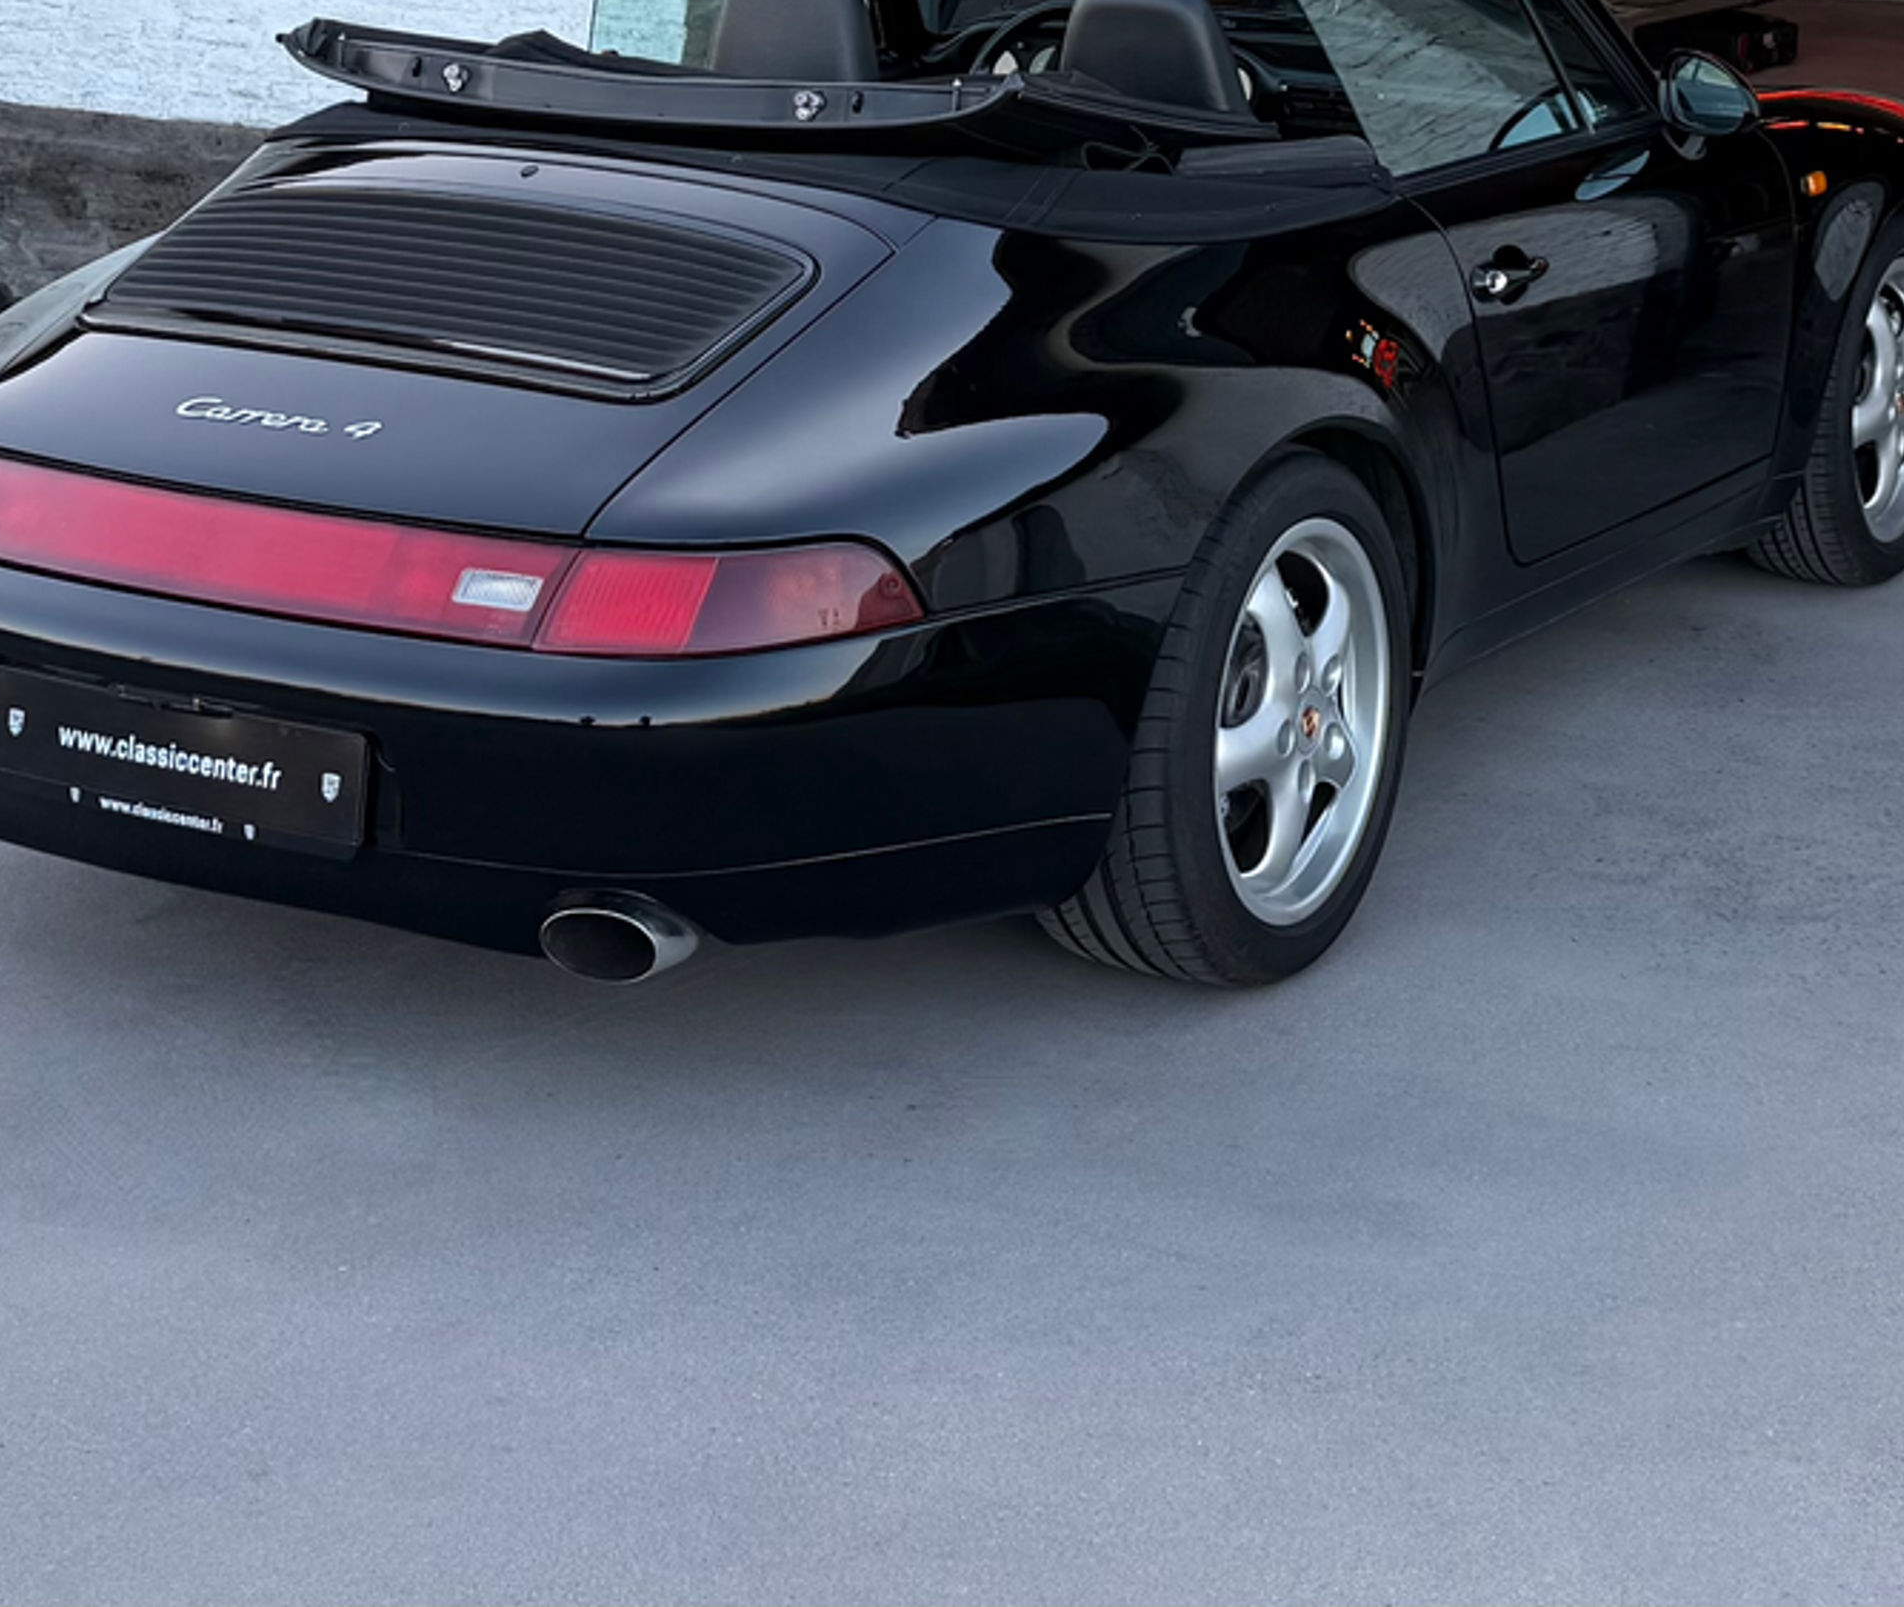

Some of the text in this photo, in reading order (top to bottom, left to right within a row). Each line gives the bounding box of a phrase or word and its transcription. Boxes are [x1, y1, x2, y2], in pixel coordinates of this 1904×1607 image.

[175, 395, 384, 441] Carrera 4
[57, 723, 283, 790] www.classiccenter.fr
[98, 794, 224, 834] www.classiccenter.fr
